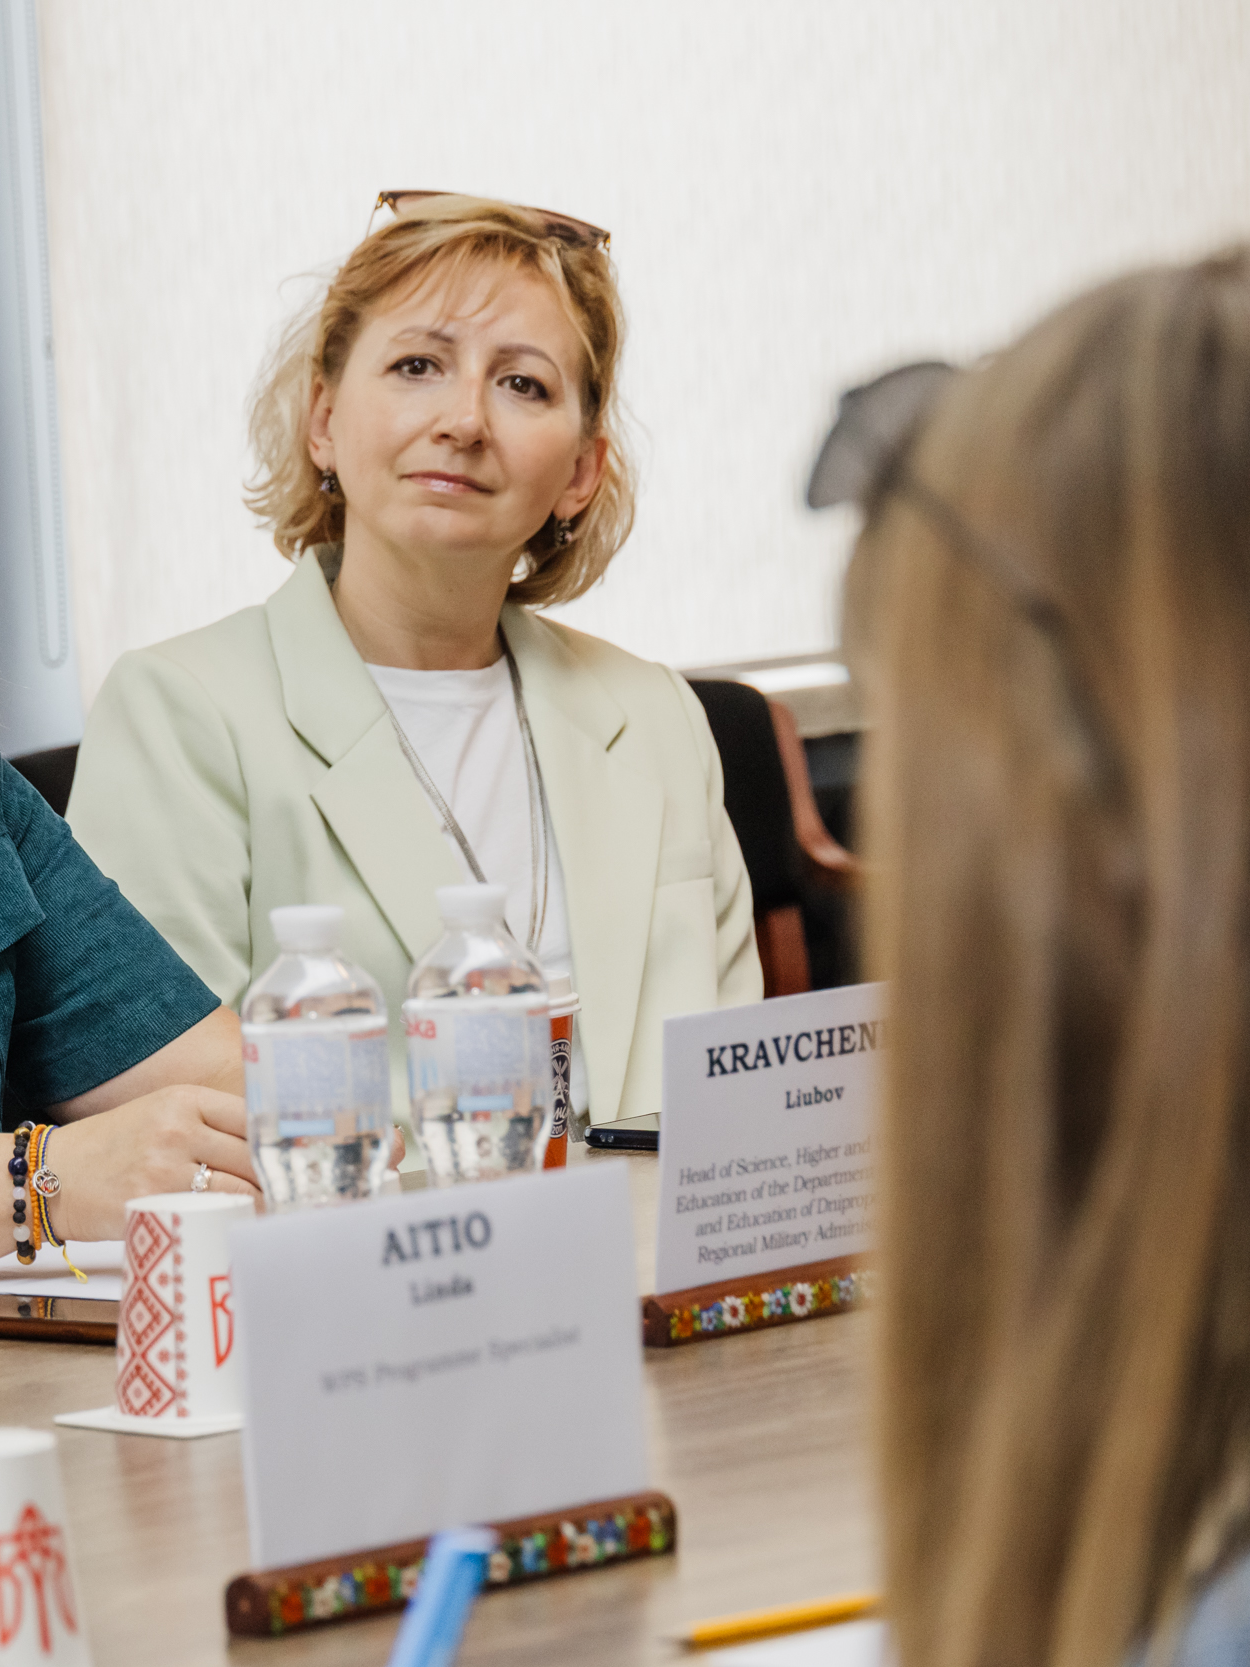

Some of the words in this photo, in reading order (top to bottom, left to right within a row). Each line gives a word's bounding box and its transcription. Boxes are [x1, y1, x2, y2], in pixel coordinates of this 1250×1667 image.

[707, 1020, 882, 1078] KRAVCHEN
[784, 1086, 845, 1110] Liubov
[678, 1162, 716, 1187] Head
[719, 1159, 734, 1180] of
[735, 1153, 791, 1178] Science,
[796, 1143, 841, 1168] Higher
[844, 1135, 871, 1158] and
[675, 1186, 748, 1214] Education
[751, 1179, 768, 1201] of
[768, 1177, 791, 1197] the
[695, 1215, 723, 1238] and
[726, 1204, 797, 1232] Education
[800, 1197, 817, 1218] of
[382, 1211, 493, 1267] AITIO
[697, 1236, 758, 1266] Regional
[760, 1228, 812, 1253] Military
[410, 1273, 475, 1307] Linda
[487, 1325, 581, 1363] Specialist
